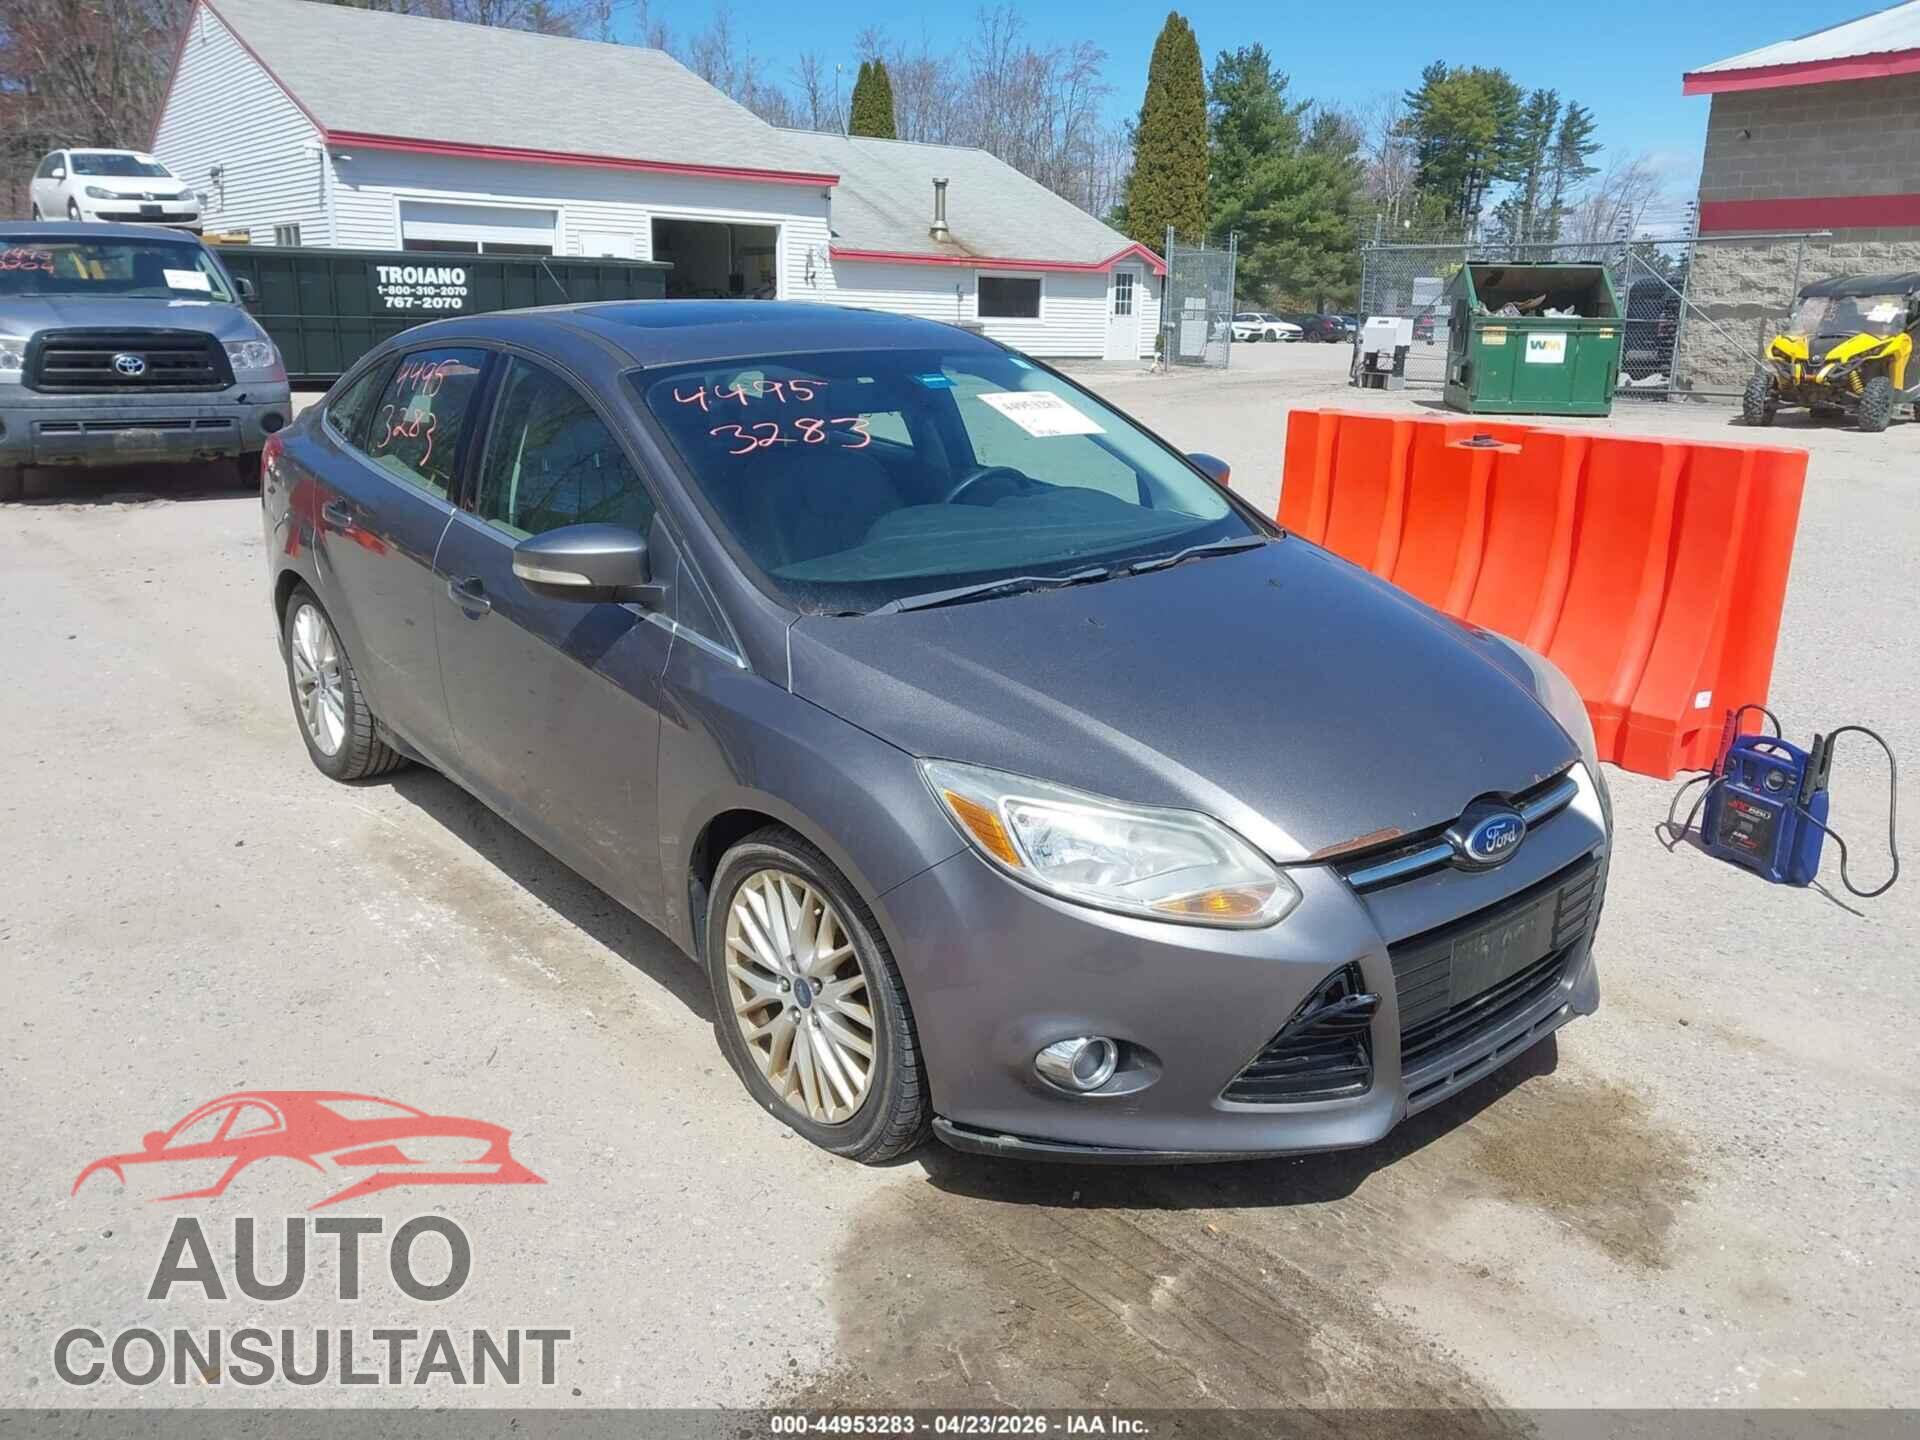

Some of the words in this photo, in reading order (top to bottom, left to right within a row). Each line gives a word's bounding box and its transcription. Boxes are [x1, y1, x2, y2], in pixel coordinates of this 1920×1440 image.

[376, 266, 466, 285] TROIANO
[376, 285, 468, 296] 1-800-310-2070
[383, 296, 463, 308] 767-2070
[1529, 339, 1561, 351] WM
[674, 379, 829, 412] 4495
[377, 404, 437, 466] 3283
[709, 417, 872, 454] 3283
[1486, 822, 1518, 852] Ford
